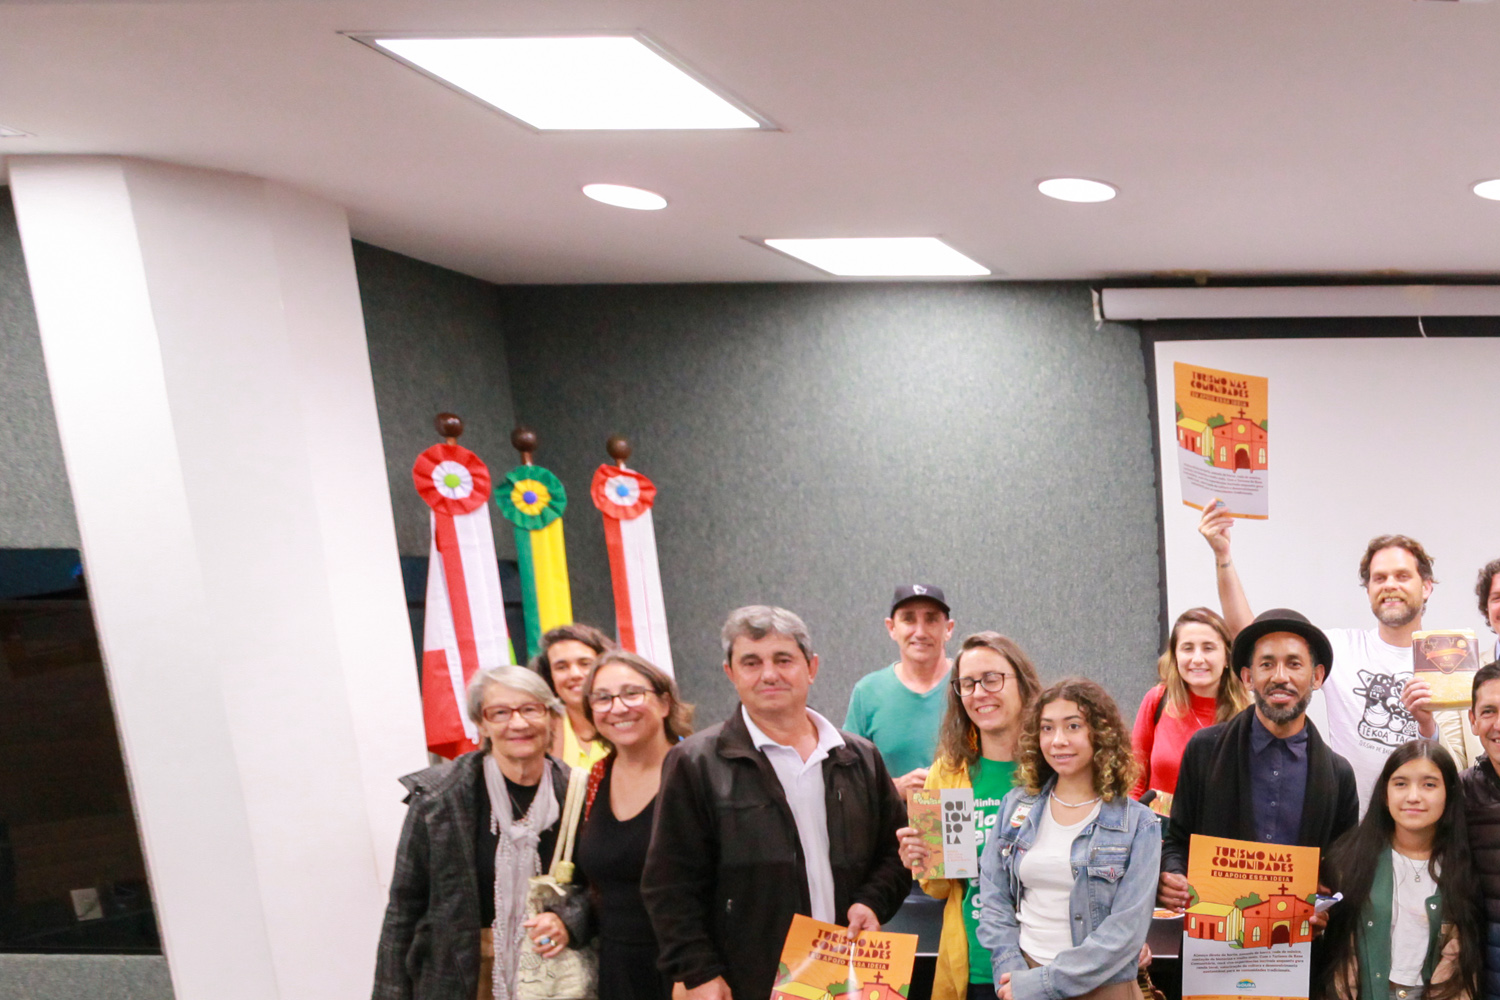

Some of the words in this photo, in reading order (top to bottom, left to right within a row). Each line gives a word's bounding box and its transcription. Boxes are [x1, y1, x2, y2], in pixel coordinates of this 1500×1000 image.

[945, 801, 966, 811] QUI
[946, 812, 971, 822] LOM
[946, 823, 963, 833] BO
[947, 835, 961, 844] LA
[1216, 846, 1265, 860] TURISMO
[1269, 853, 1292, 862] NAS
[1212, 857, 1293, 872] COMUNIDADES
[869, 940, 891, 949] NAS
[823, 955, 845, 965] APOIO
